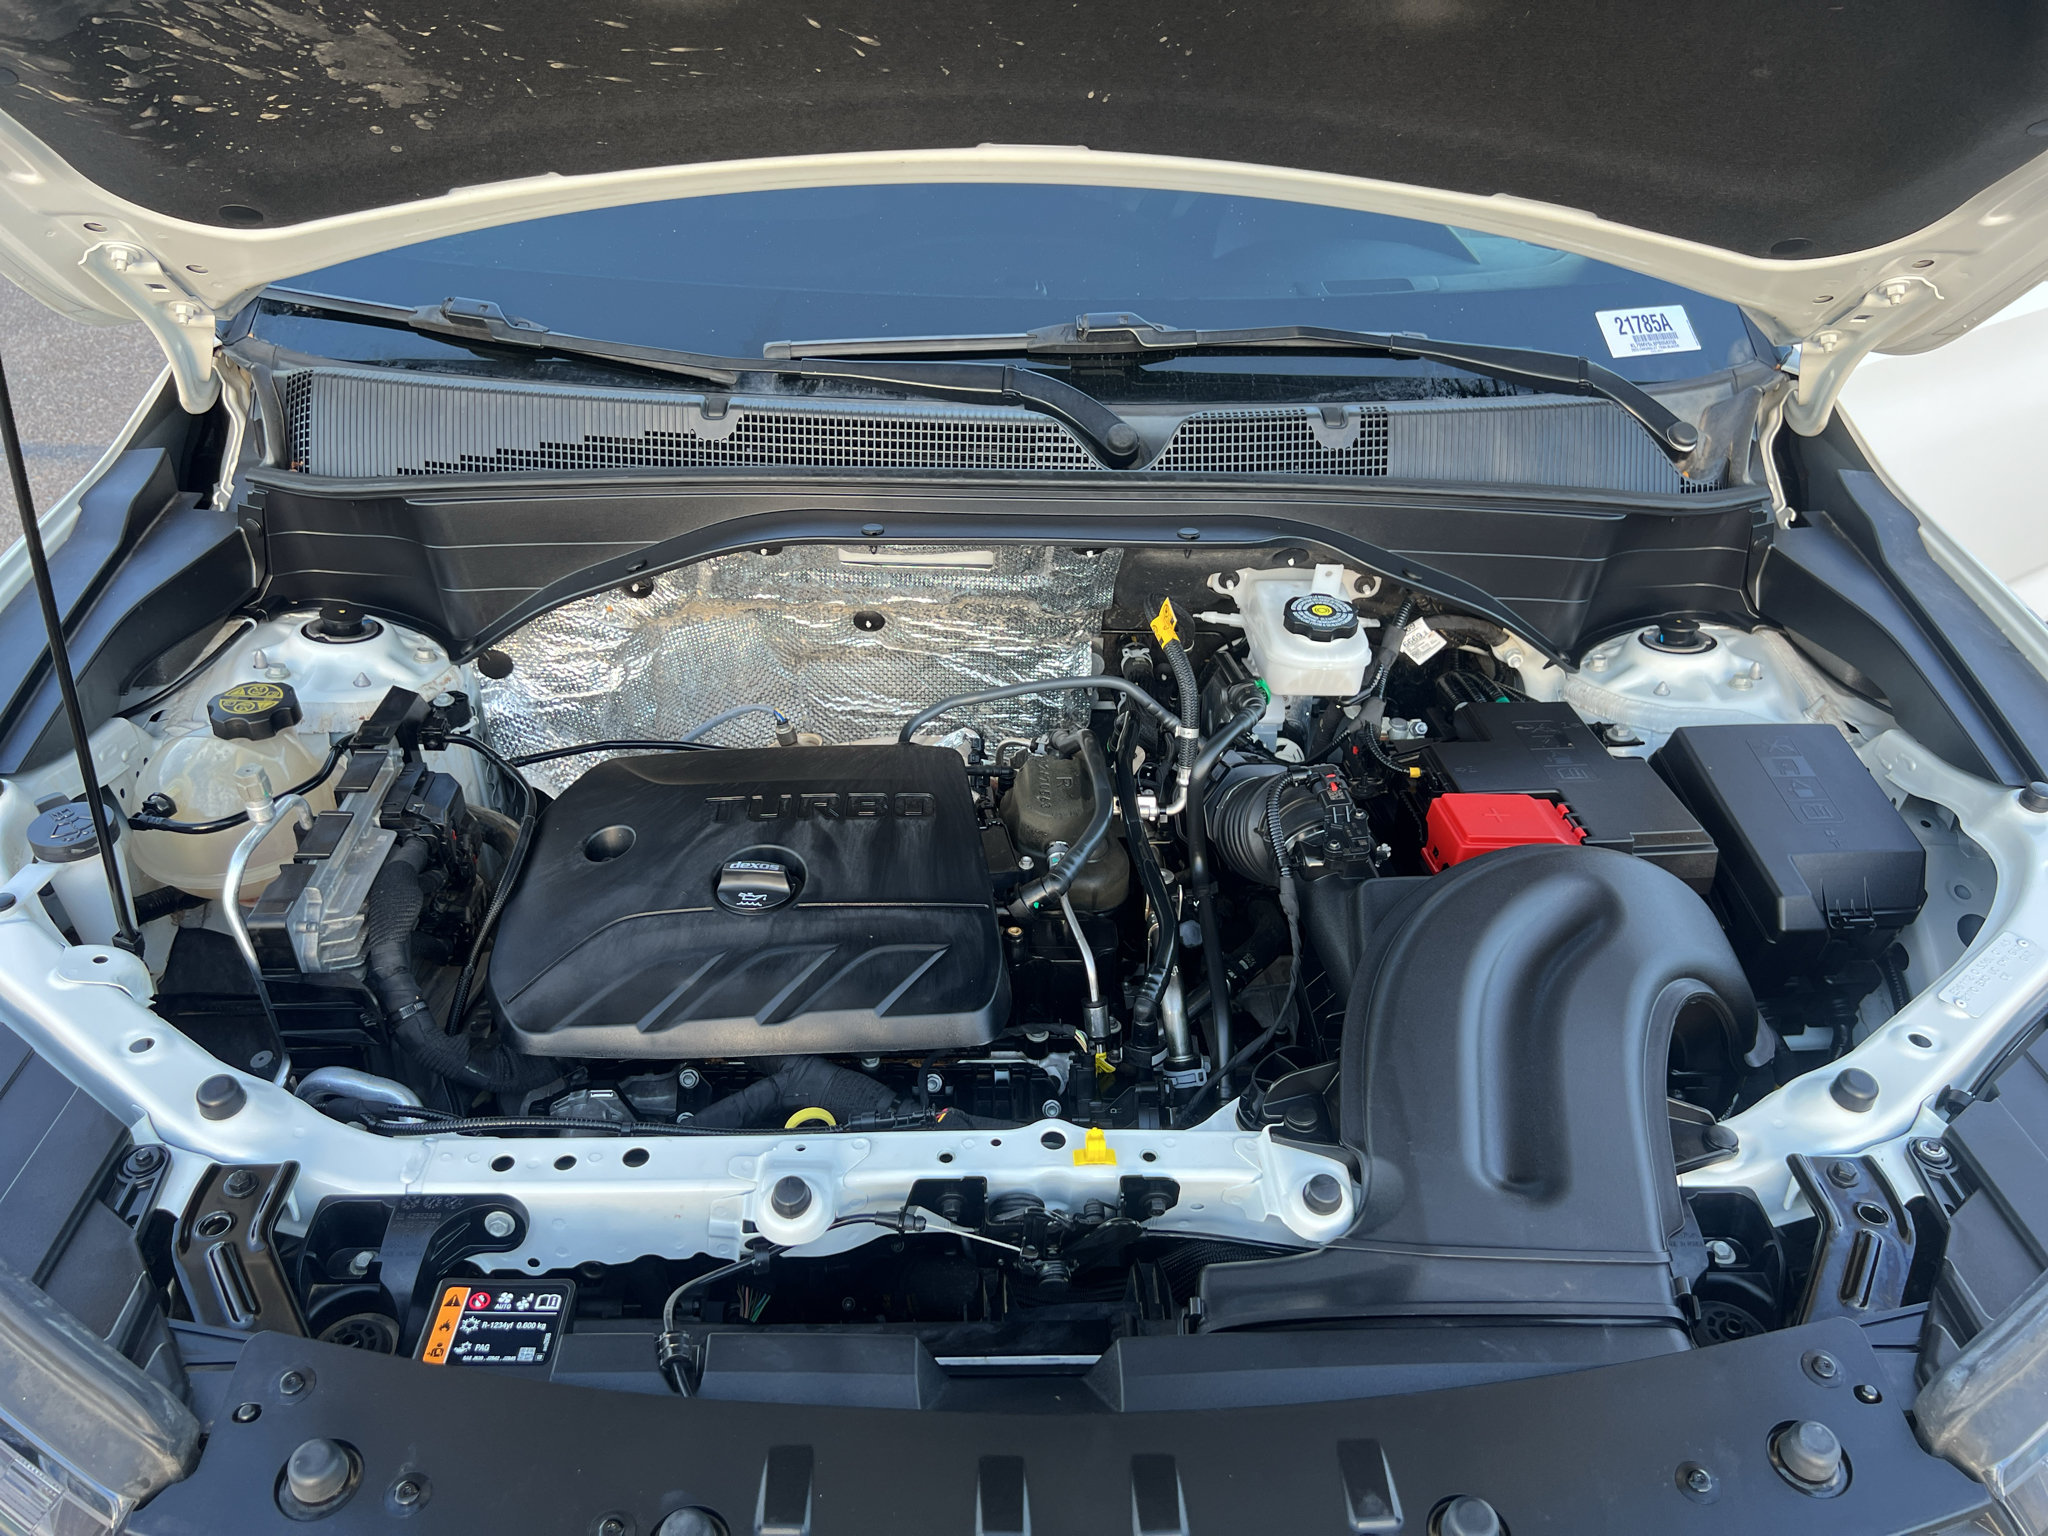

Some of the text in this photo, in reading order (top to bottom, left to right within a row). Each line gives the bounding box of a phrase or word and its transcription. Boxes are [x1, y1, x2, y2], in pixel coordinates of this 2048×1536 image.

[1614, 313, 1674, 336] 21785A
[705, 792, 936, 824] TURBO
[729, 861, 781, 871] dexos
[481, 1321, 514, 1331] R-1234yf
[537, 1321, 547, 1331] kg
[474, 1343, 491, 1352] PAG
